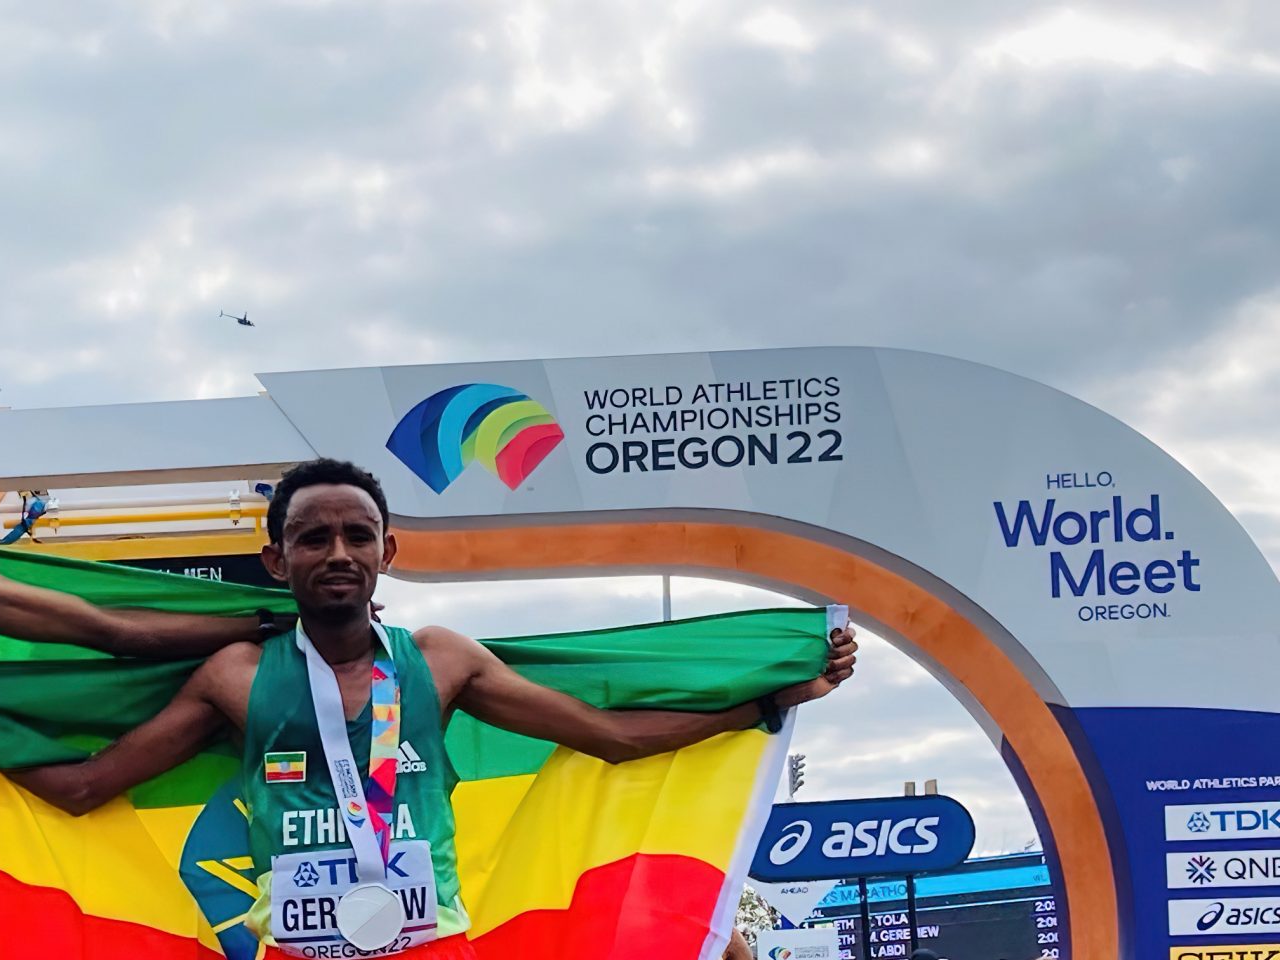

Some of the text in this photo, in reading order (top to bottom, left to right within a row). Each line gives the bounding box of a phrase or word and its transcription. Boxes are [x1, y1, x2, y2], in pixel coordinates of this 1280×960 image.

[584, 376, 841, 410] WORLD ATHLETICS
[585, 401, 841, 436] CHAMPIONSHIPS
[1046, 471, 1116, 490] HELLO,
[992, 494, 1175, 548] World.
[1049, 548, 1201, 598] Meet
[1146, 779, 1190, 791] WORLD
[1192, 776, 1257, 790] ATHLETICS
[282, 803, 417, 846] ETHIA
[1210, 809, 1280, 831] TDK
[318, 851, 410, 885] TK
[282, 886, 427, 932] GERW
[875, 913, 908, 927] TOLA
[878, 944, 906, 957] ABDI
[880, 925, 940, 942] GEREEW
